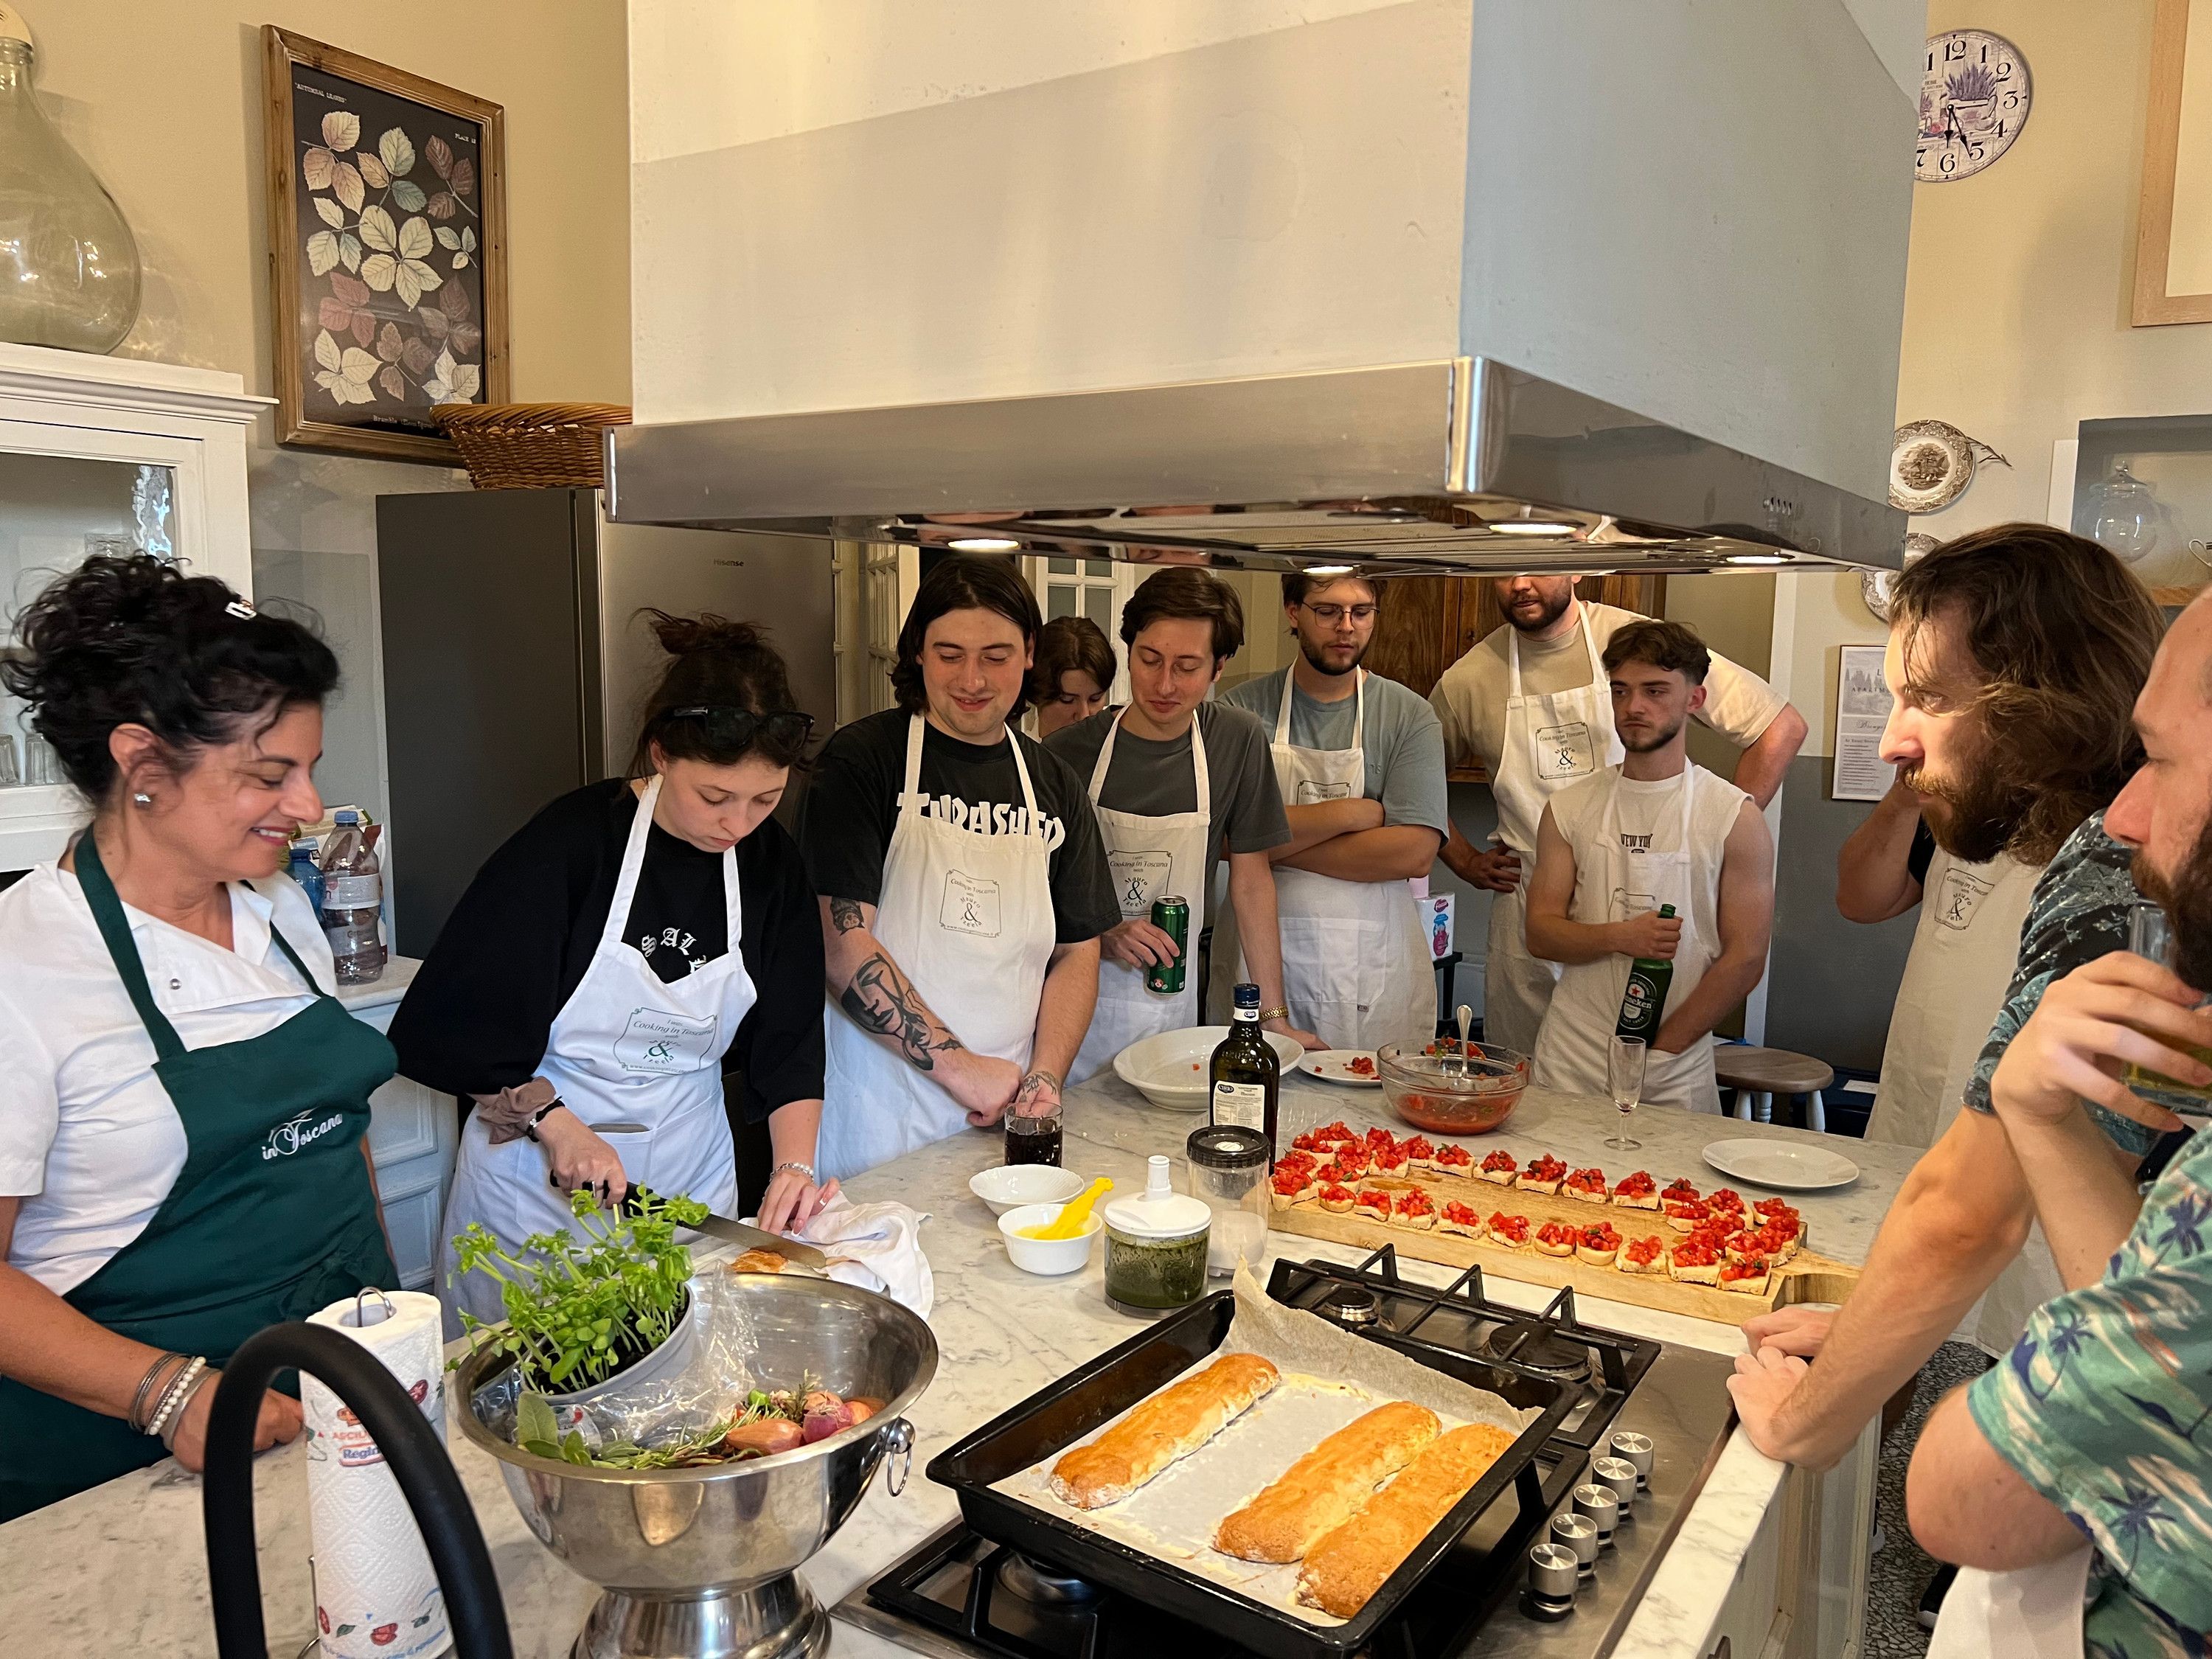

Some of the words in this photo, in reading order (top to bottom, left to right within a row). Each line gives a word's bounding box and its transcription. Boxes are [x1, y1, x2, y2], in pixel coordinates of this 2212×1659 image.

[1944, 40, 1966, 61] 12
[1980, 44, 1987, 63] 1
[1995, 62, 2011, 83] 2
[2003, 90, 2019, 110] 3
[1991, 119, 2008, 138] 4
[1916, 148, 1927, 167] 7
[1968, 141, 1984, 161] 5
[1939, 153, 1955, 173] 6
[1559, 750, 1573, 765] &
[1124, 877, 1148, 886] Mauro
[1127, 880, 1144, 900] &
[964, 902, 979, 922] &
[633, 1020, 669, 1033] Cooking
[273, 1113, 343, 1155] Toscana
[343, 1447, 380, 1459] Regin
